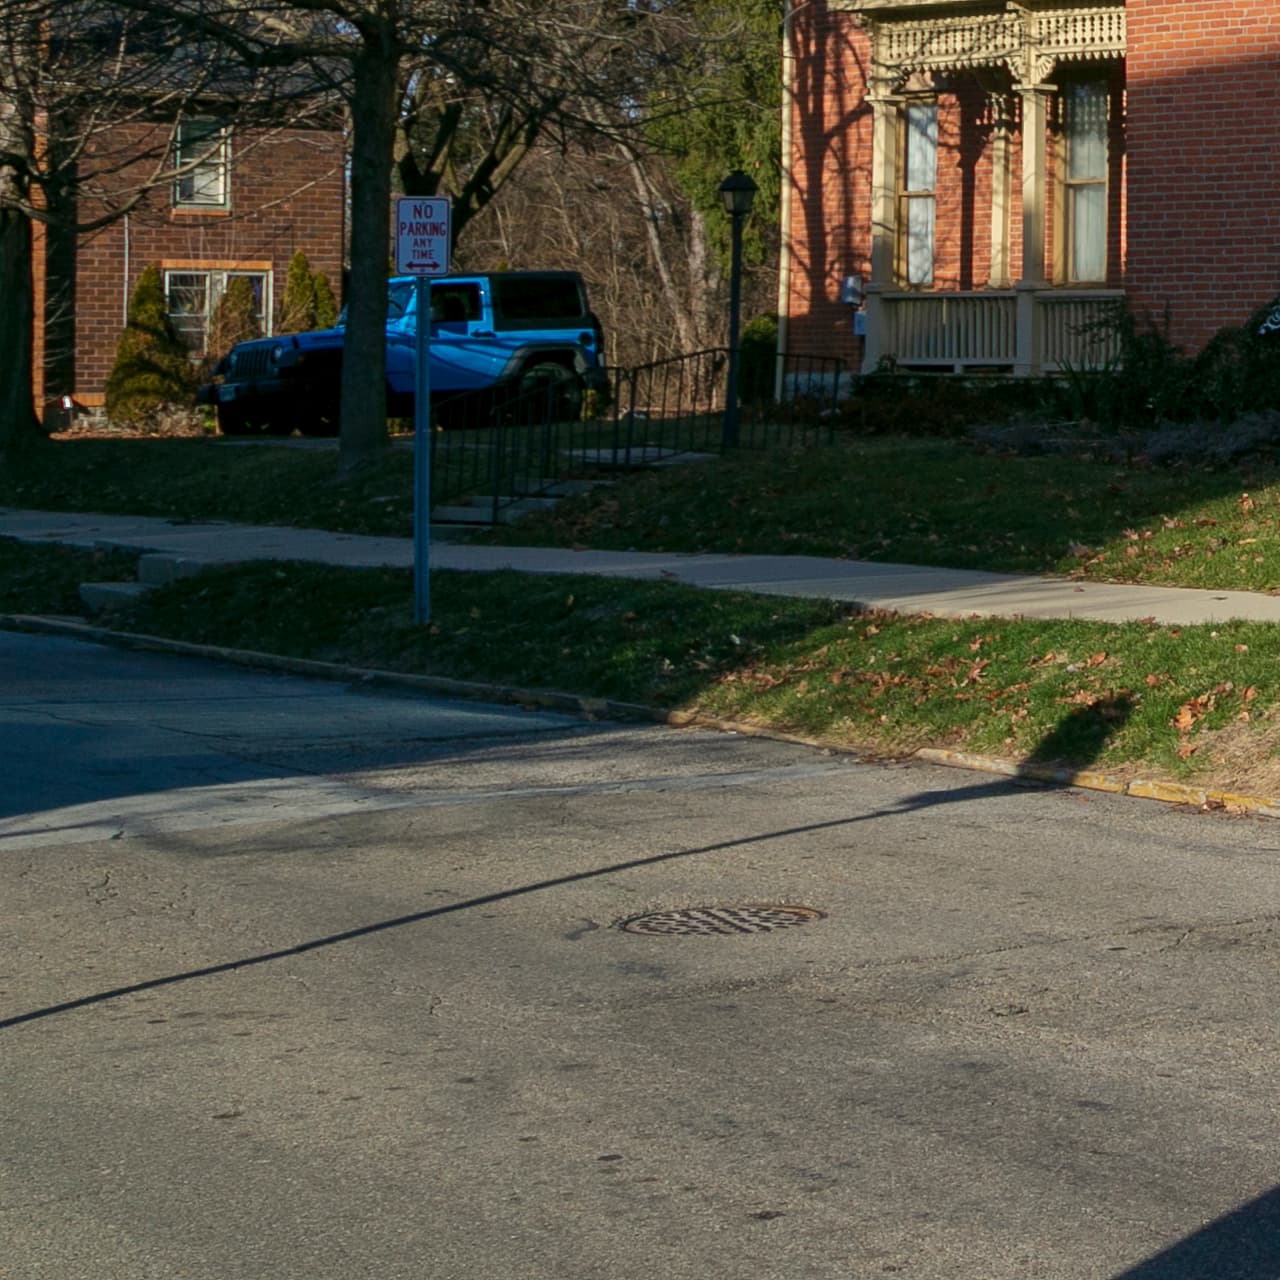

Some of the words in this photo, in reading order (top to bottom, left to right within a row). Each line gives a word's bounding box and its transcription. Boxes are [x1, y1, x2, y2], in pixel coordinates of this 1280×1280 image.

[413, 204, 433, 219] NO
[400, 221, 446, 237] PARKING
[413, 238, 433, 248] ANY
[412, 249, 434, 260] TIME
